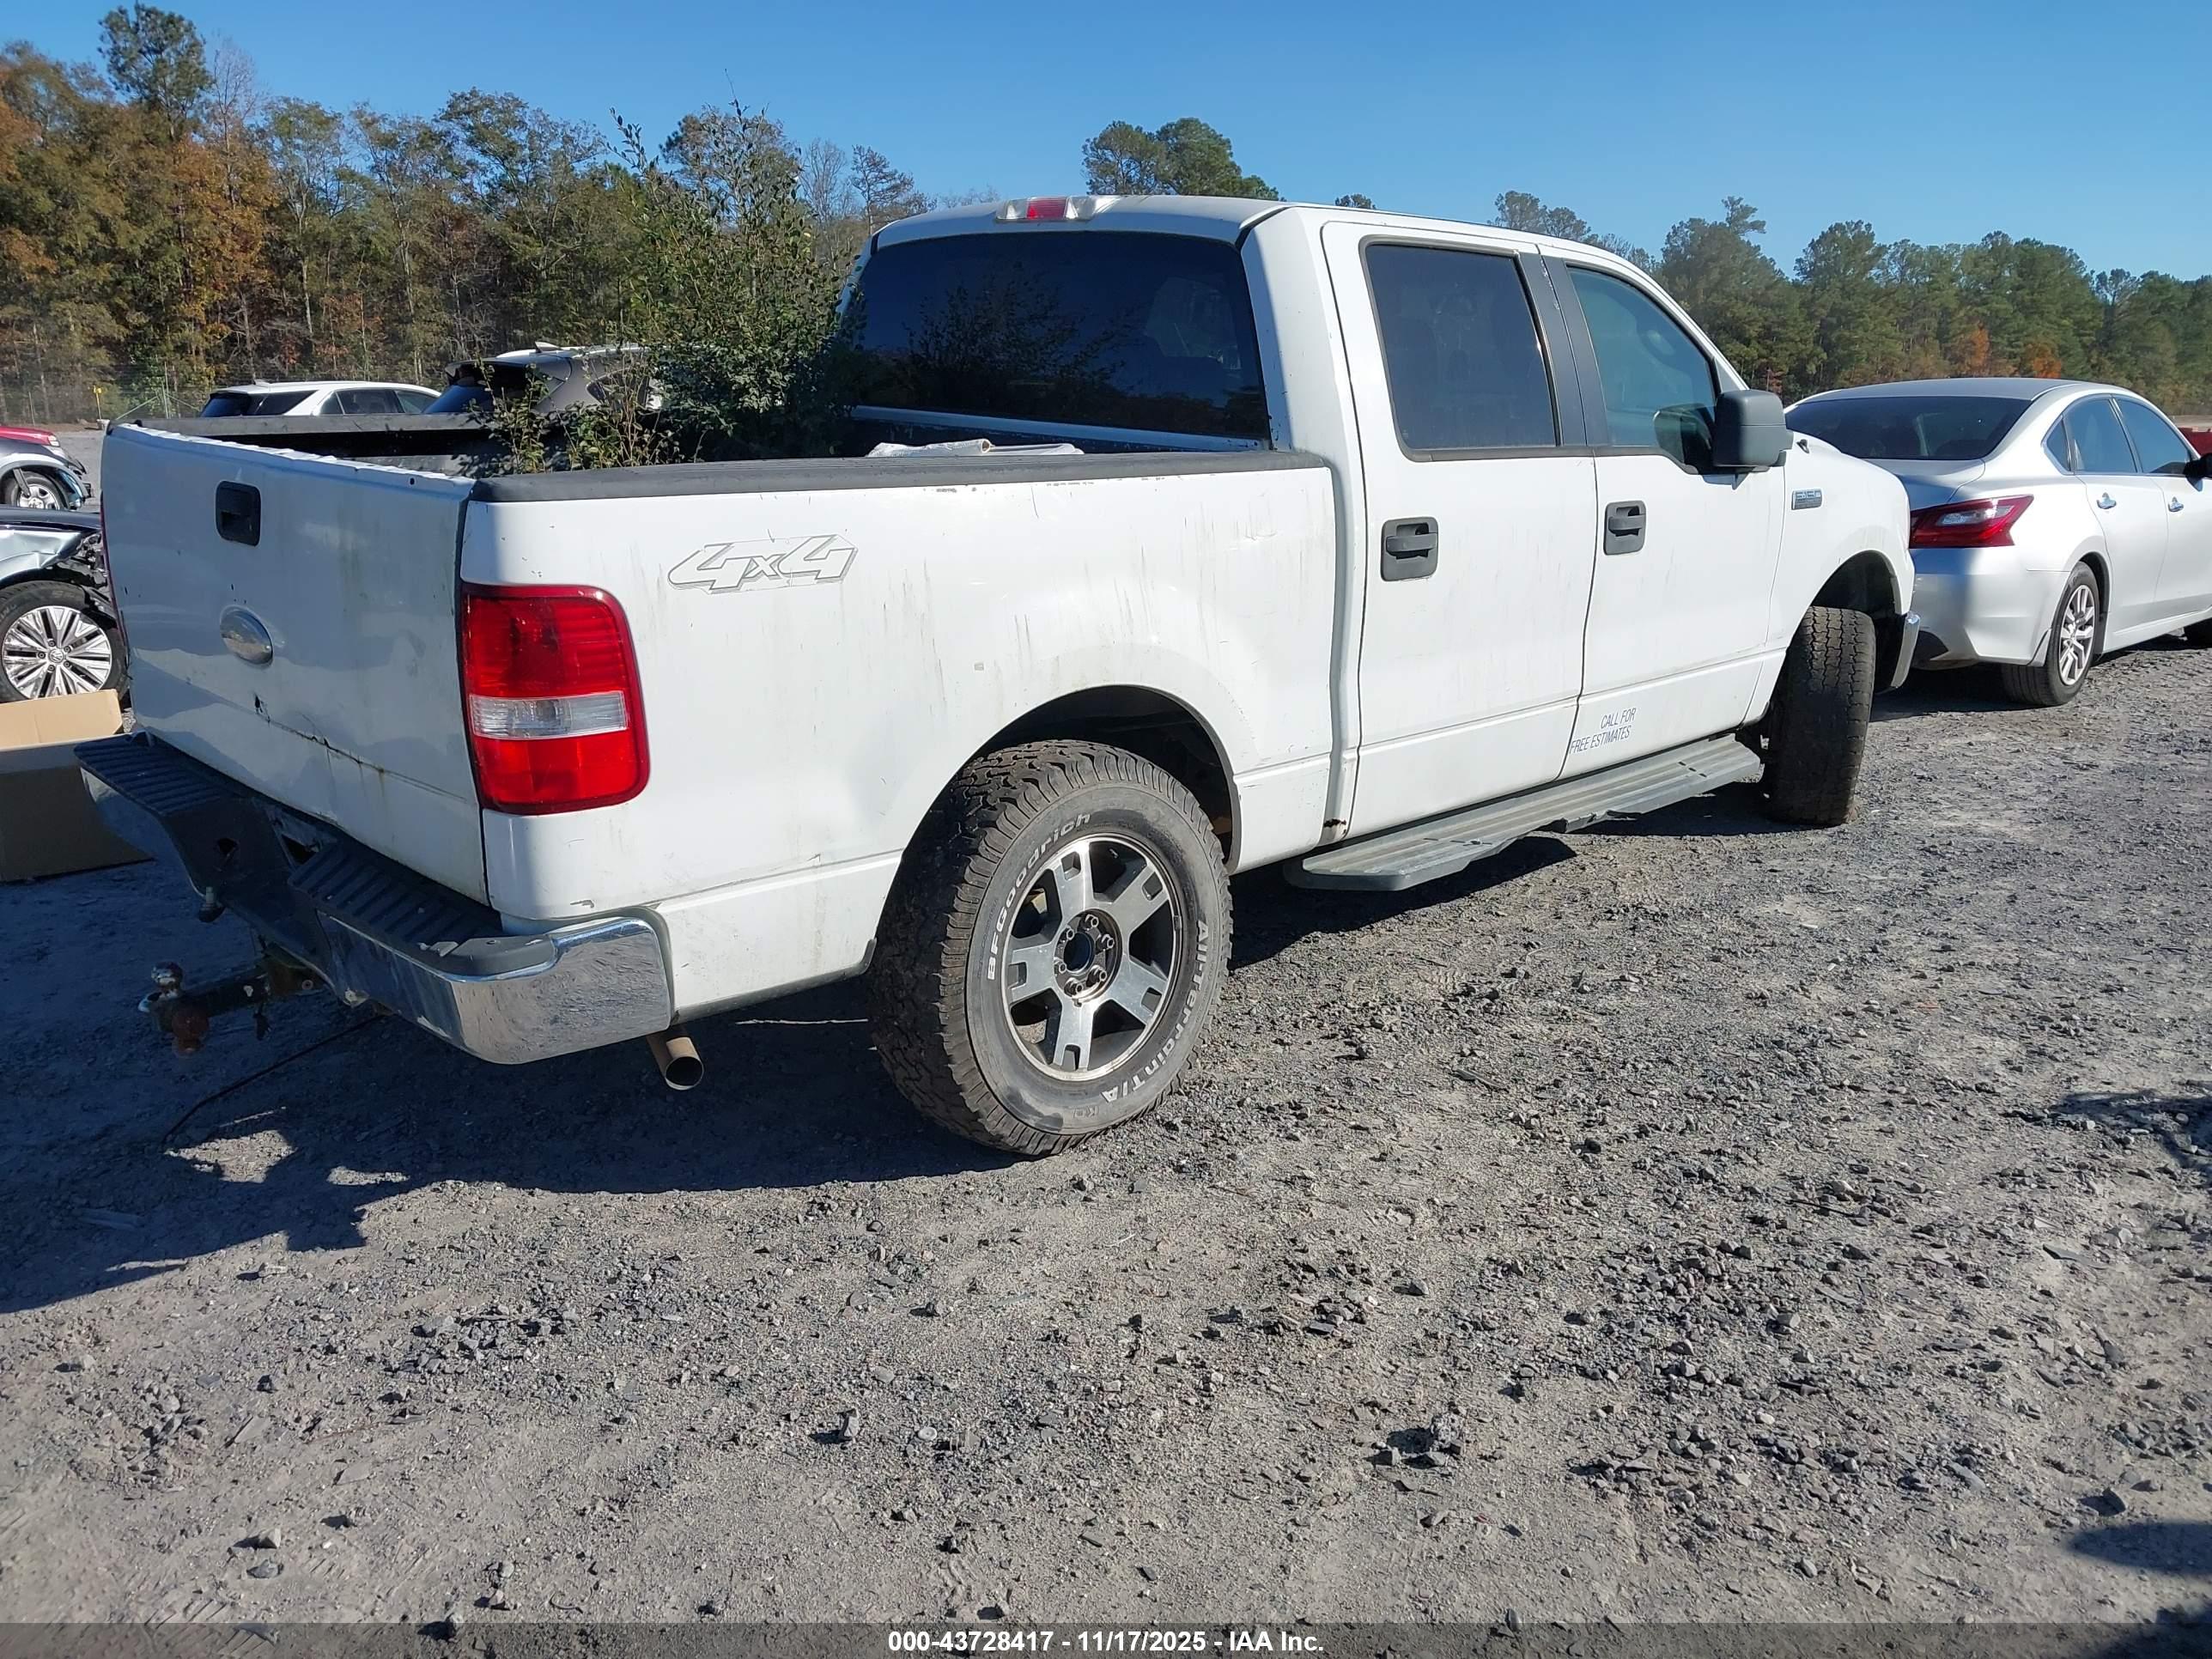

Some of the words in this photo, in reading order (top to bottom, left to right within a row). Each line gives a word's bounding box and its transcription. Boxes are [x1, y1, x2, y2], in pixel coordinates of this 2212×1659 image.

[667, 533, 857, 593] 4x4
[1569, 736, 1591, 754] FREE
[1589, 725, 1632, 749] ESTIMATES
[1601, 711, 1620, 729] CALL
[1620, 707, 1637, 724] FOR
[987, 812, 1091, 981] BFGoodrich
[1144, 920, 1208, 1076] All-Terrain
[1101, 1074, 1146, 1103] T/A
